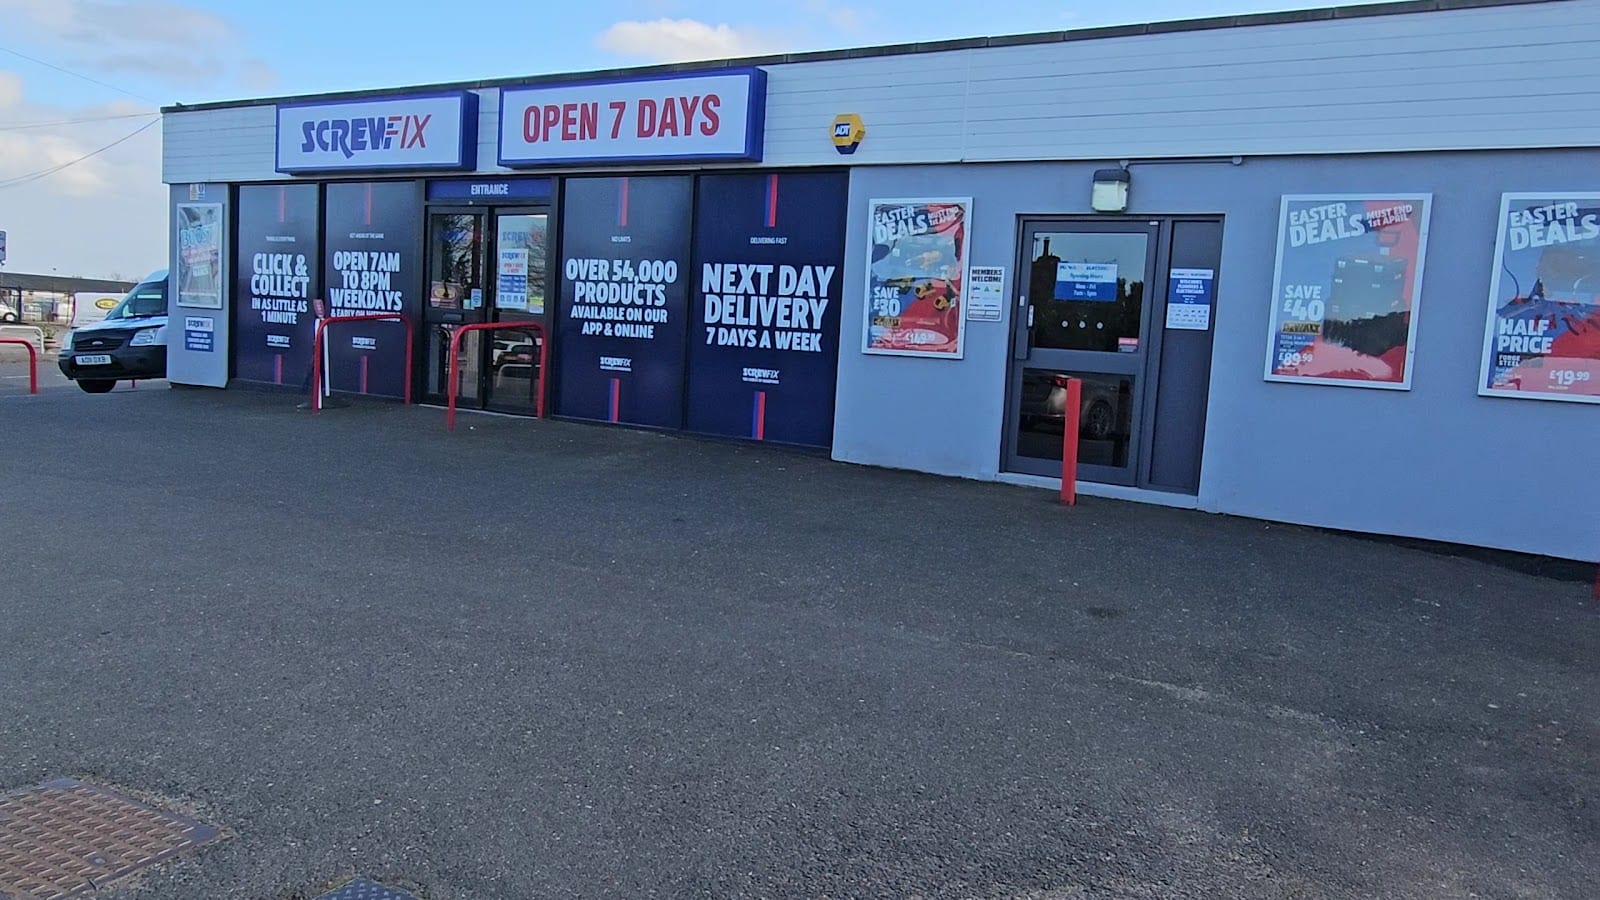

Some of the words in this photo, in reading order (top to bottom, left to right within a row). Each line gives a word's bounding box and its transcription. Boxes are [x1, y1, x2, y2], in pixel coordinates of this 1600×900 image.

[523, 102, 598, 144] OPEN
[609, 101, 627, 139] 7
[637, 93, 721, 138] DAYS
[301, 114, 432, 159] SCREWFIX
[835, 125, 850, 135] ADT
[471, 184, 509, 195] ENTRANCE
[874, 206, 915, 225] EASTER
[1290, 202, 1347, 226] EASTER
[1366, 207, 1391, 219] MUST
[1393, 204, 1413, 216] END
[1368, 218, 1381, 228] 1st
[1382, 214, 1410, 226] APRIL
[1509, 202, 1579, 227] EASTER
[874, 214, 928, 245] DEALS
[1289, 213, 1365, 248] DEALS
[1510, 214, 1600, 251] DEALS
[253, 253, 292, 274] CLICK
[295, 254, 307, 276] &
[333, 252, 370, 271] OPEN
[371, 252, 400, 272] 7AM
[566, 258, 610, 281] OVER
[612, 260, 678, 285] 54,000
[251, 275, 309, 298] COLLECT
[342, 270, 360, 289] TO
[361, 271, 390, 291] 8PM
[702, 263, 773, 295] NEXT
[778, 265, 835, 297] DAY
[330, 288, 402, 311] WEEKDAYS
[574, 283, 666, 306] PRODUCTS
[873, 286, 899, 299] SAVE
[1285, 285, 1322, 299] SAVE
[252, 298, 260, 310] IN
[261, 298, 272, 311] AS
[273, 299, 295, 312] LITTLE
[297, 300, 307, 313] AS
[570, 305, 625, 322] AVAILABLE
[626, 308, 642, 322] ON
[644, 309, 668, 323] OUR
[704, 295, 829, 329] DELIVERY
[873, 299, 900, 317] £30
[1283, 299, 1325, 321] £40
[261, 310, 266, 322] 1
[267, 311, 297, 324] MINUTE
[582, 322, 602, 336] APP
[604, 323, 613, 337] &
[614, 324, 654, 339] ONLINE
[1499, 318, 1550, 336] HALF
[706, 327, 715, 345] 7
[718, 328, 757, 348] DAYS
[759, 331, 771, 349] A
[775, 331, 822, 352] WEEK
[1498, 336, 1553, 354] PRICE
[600, 356, 631, 367] SCREWFIX
[1278, 353, 1313, 366] £89.99
[742, 367, 780, 379] SCREWFIX
[1549, 369, 1590, 385] £19.99
